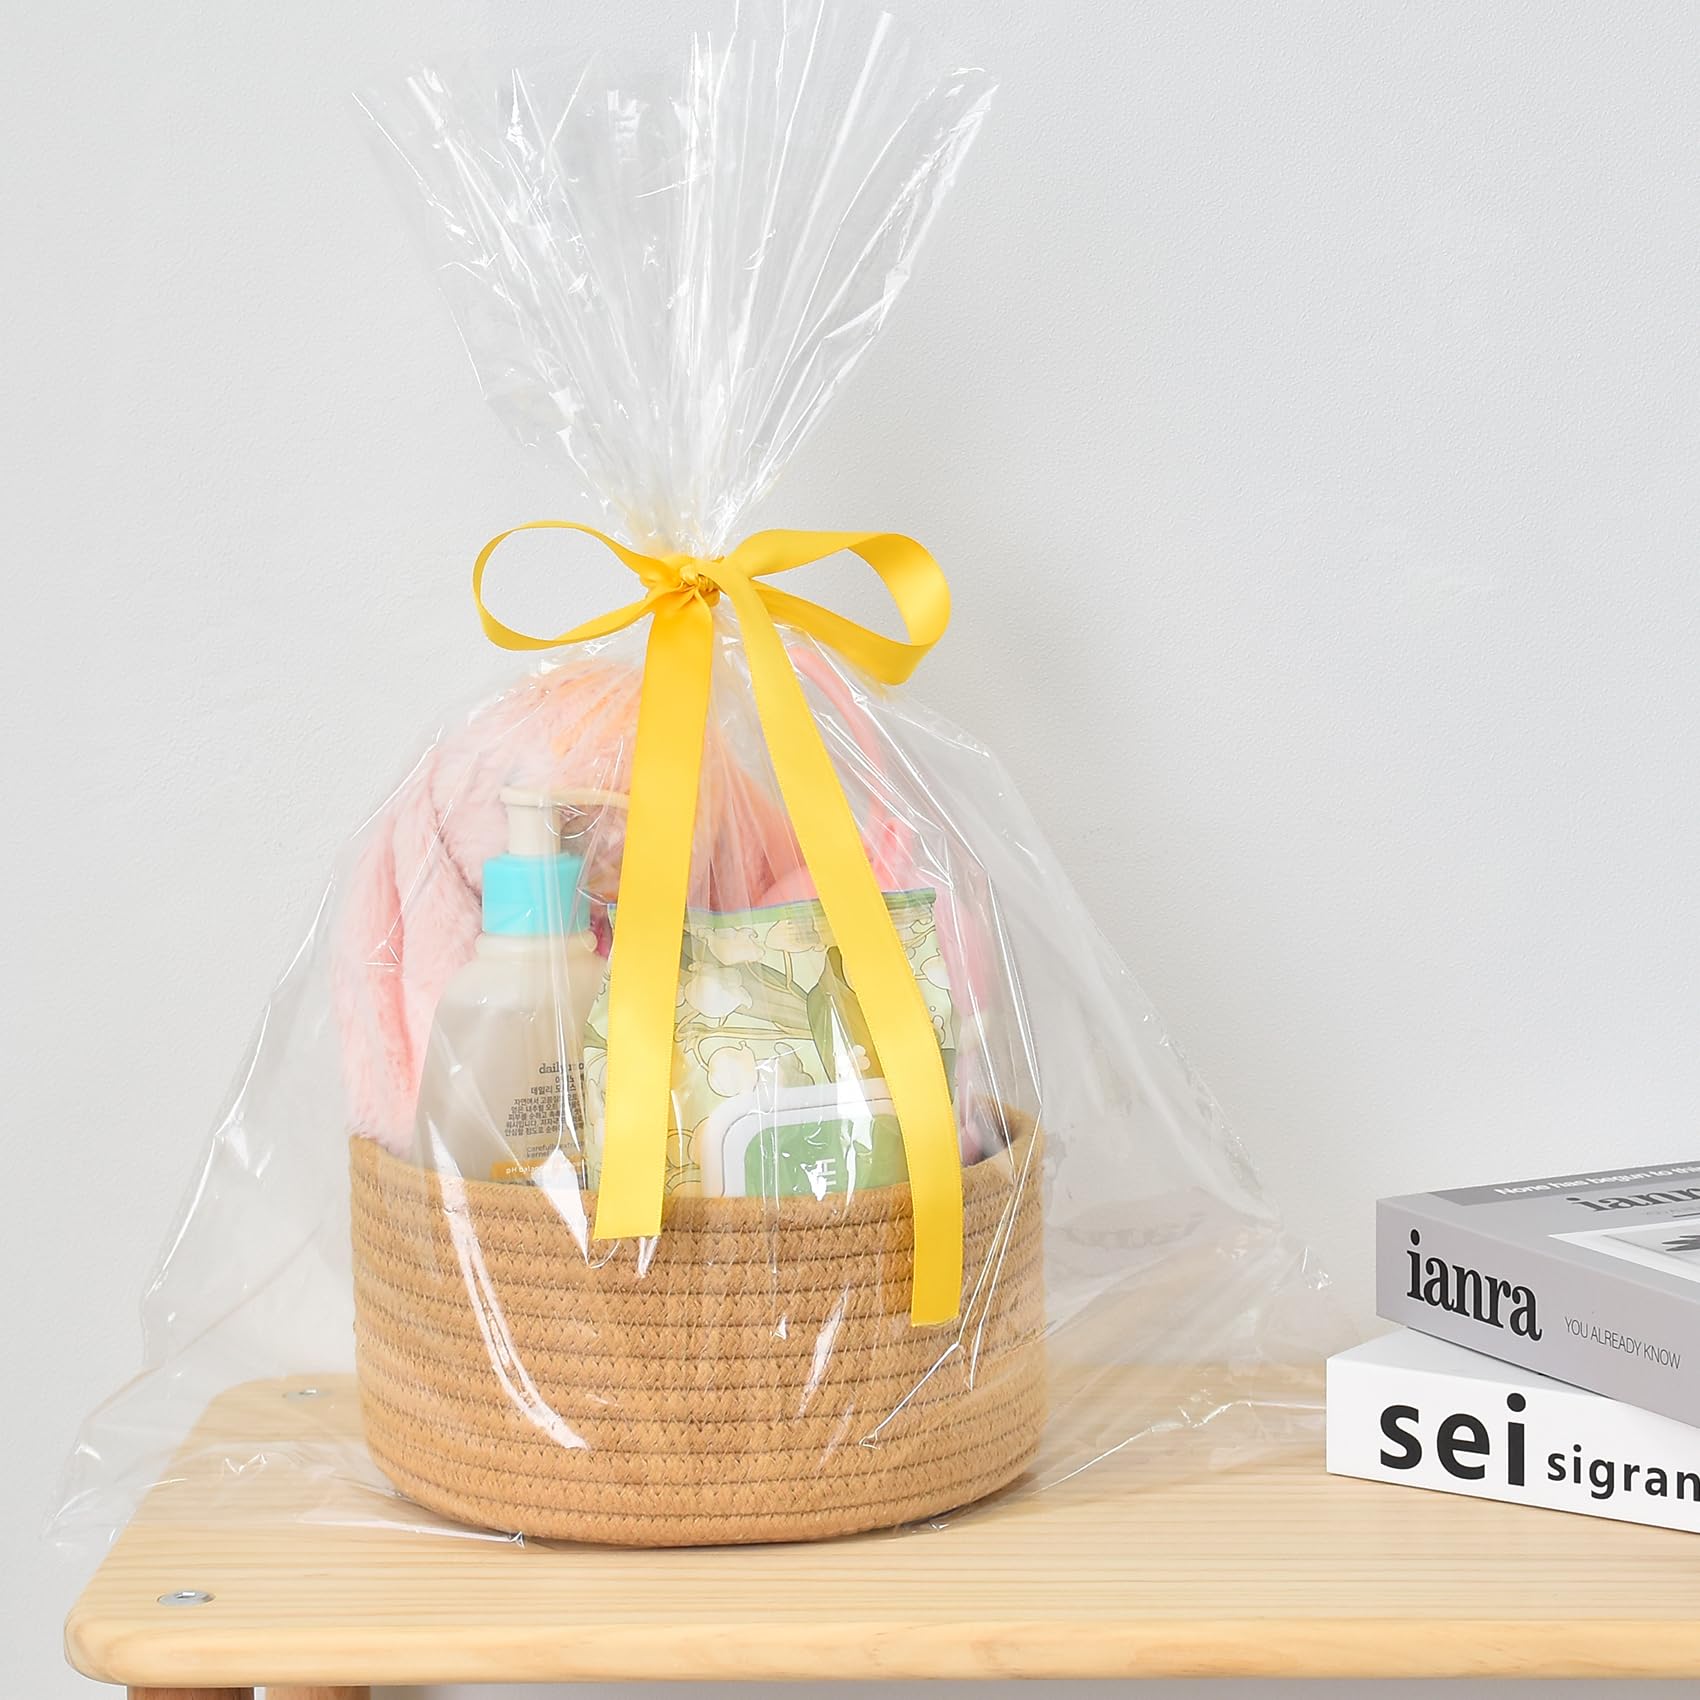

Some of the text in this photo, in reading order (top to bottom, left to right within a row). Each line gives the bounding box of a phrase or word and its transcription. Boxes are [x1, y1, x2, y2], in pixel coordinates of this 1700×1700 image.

[530, 1085, 553, 1095] 데일리
[1494, 1183, 1550, 1195] None
[1549, 1179, 1589, 1188] has
[1586, 1171, 1646, 1184] begun
[1648, 1168, 1673, 1177] to
[1406, 1228, 1681, 1369] ianra YOU ALREADY KNOW
[1379, 1392, 1527, 1487] sei
